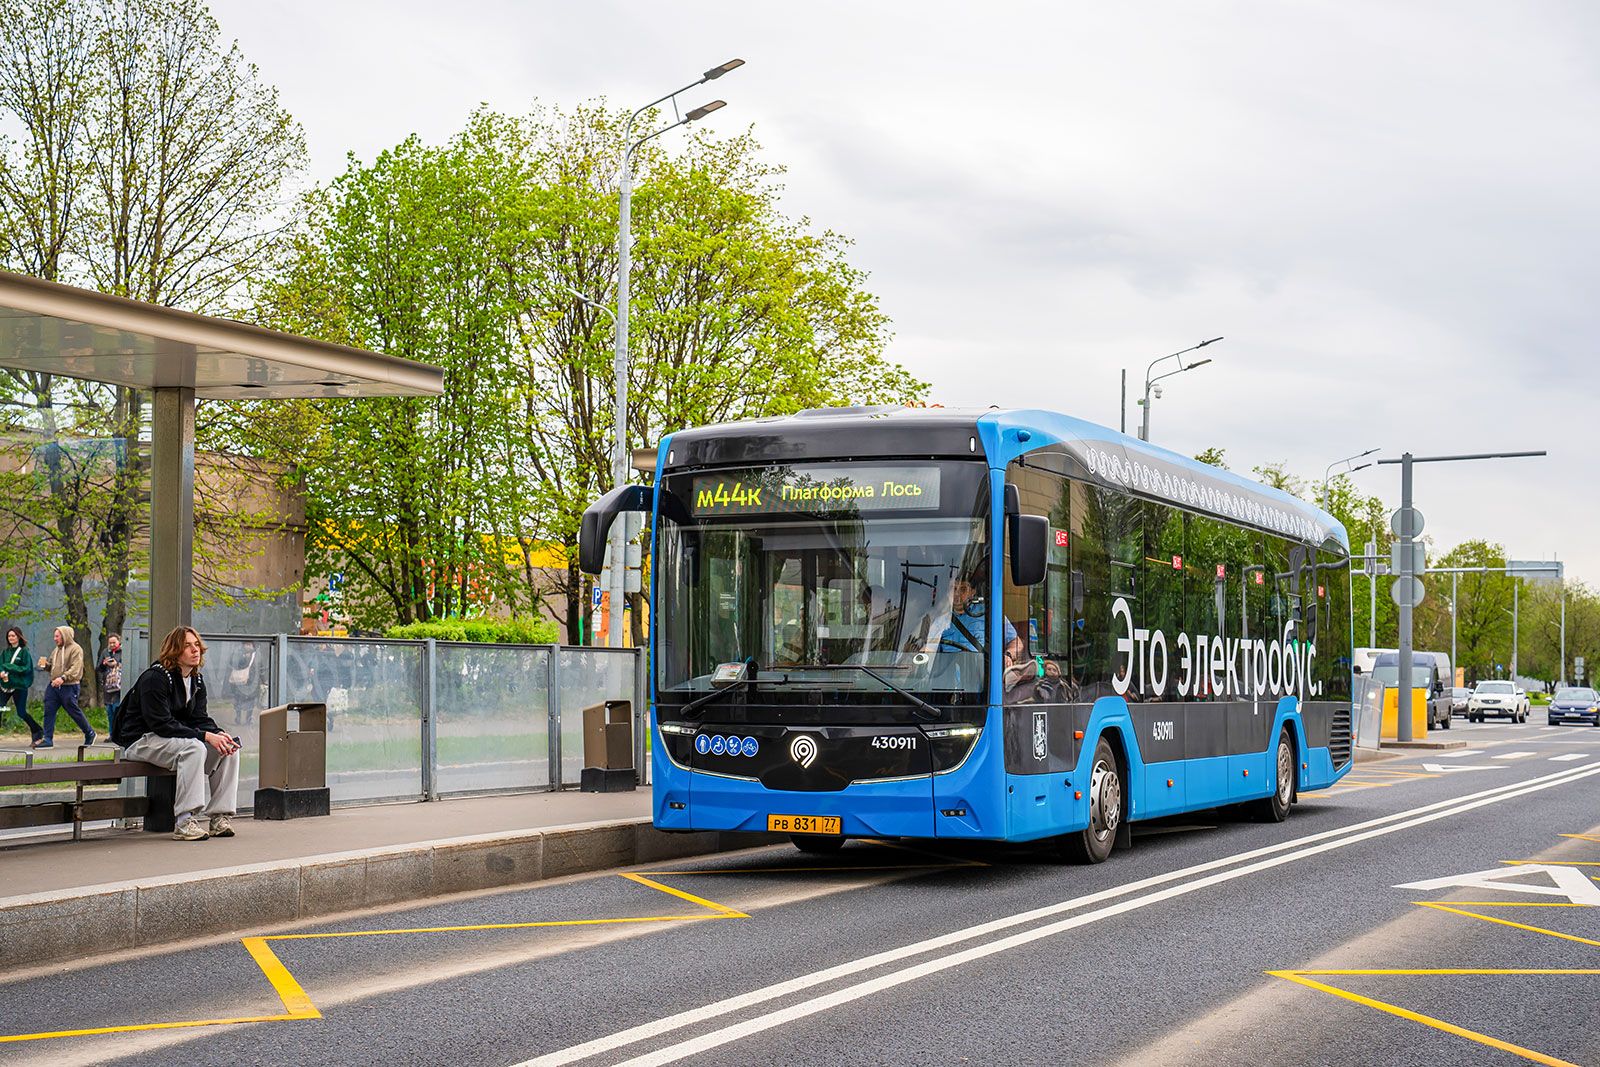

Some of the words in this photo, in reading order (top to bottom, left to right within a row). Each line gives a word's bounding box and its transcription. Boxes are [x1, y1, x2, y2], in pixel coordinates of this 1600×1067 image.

[782, 484, 874, 501] Платформа
[881, 481, 922, 497] Лось
[1111, 597, 1168, 697] Это
[1177, 619, 1323, 715] электробус.
[1153, 721, 1174, 741] 430911
[871, 736, 917, 750] 430911
[794, 818, 817, 831] 831
[824, 818, 836, 828] 77
